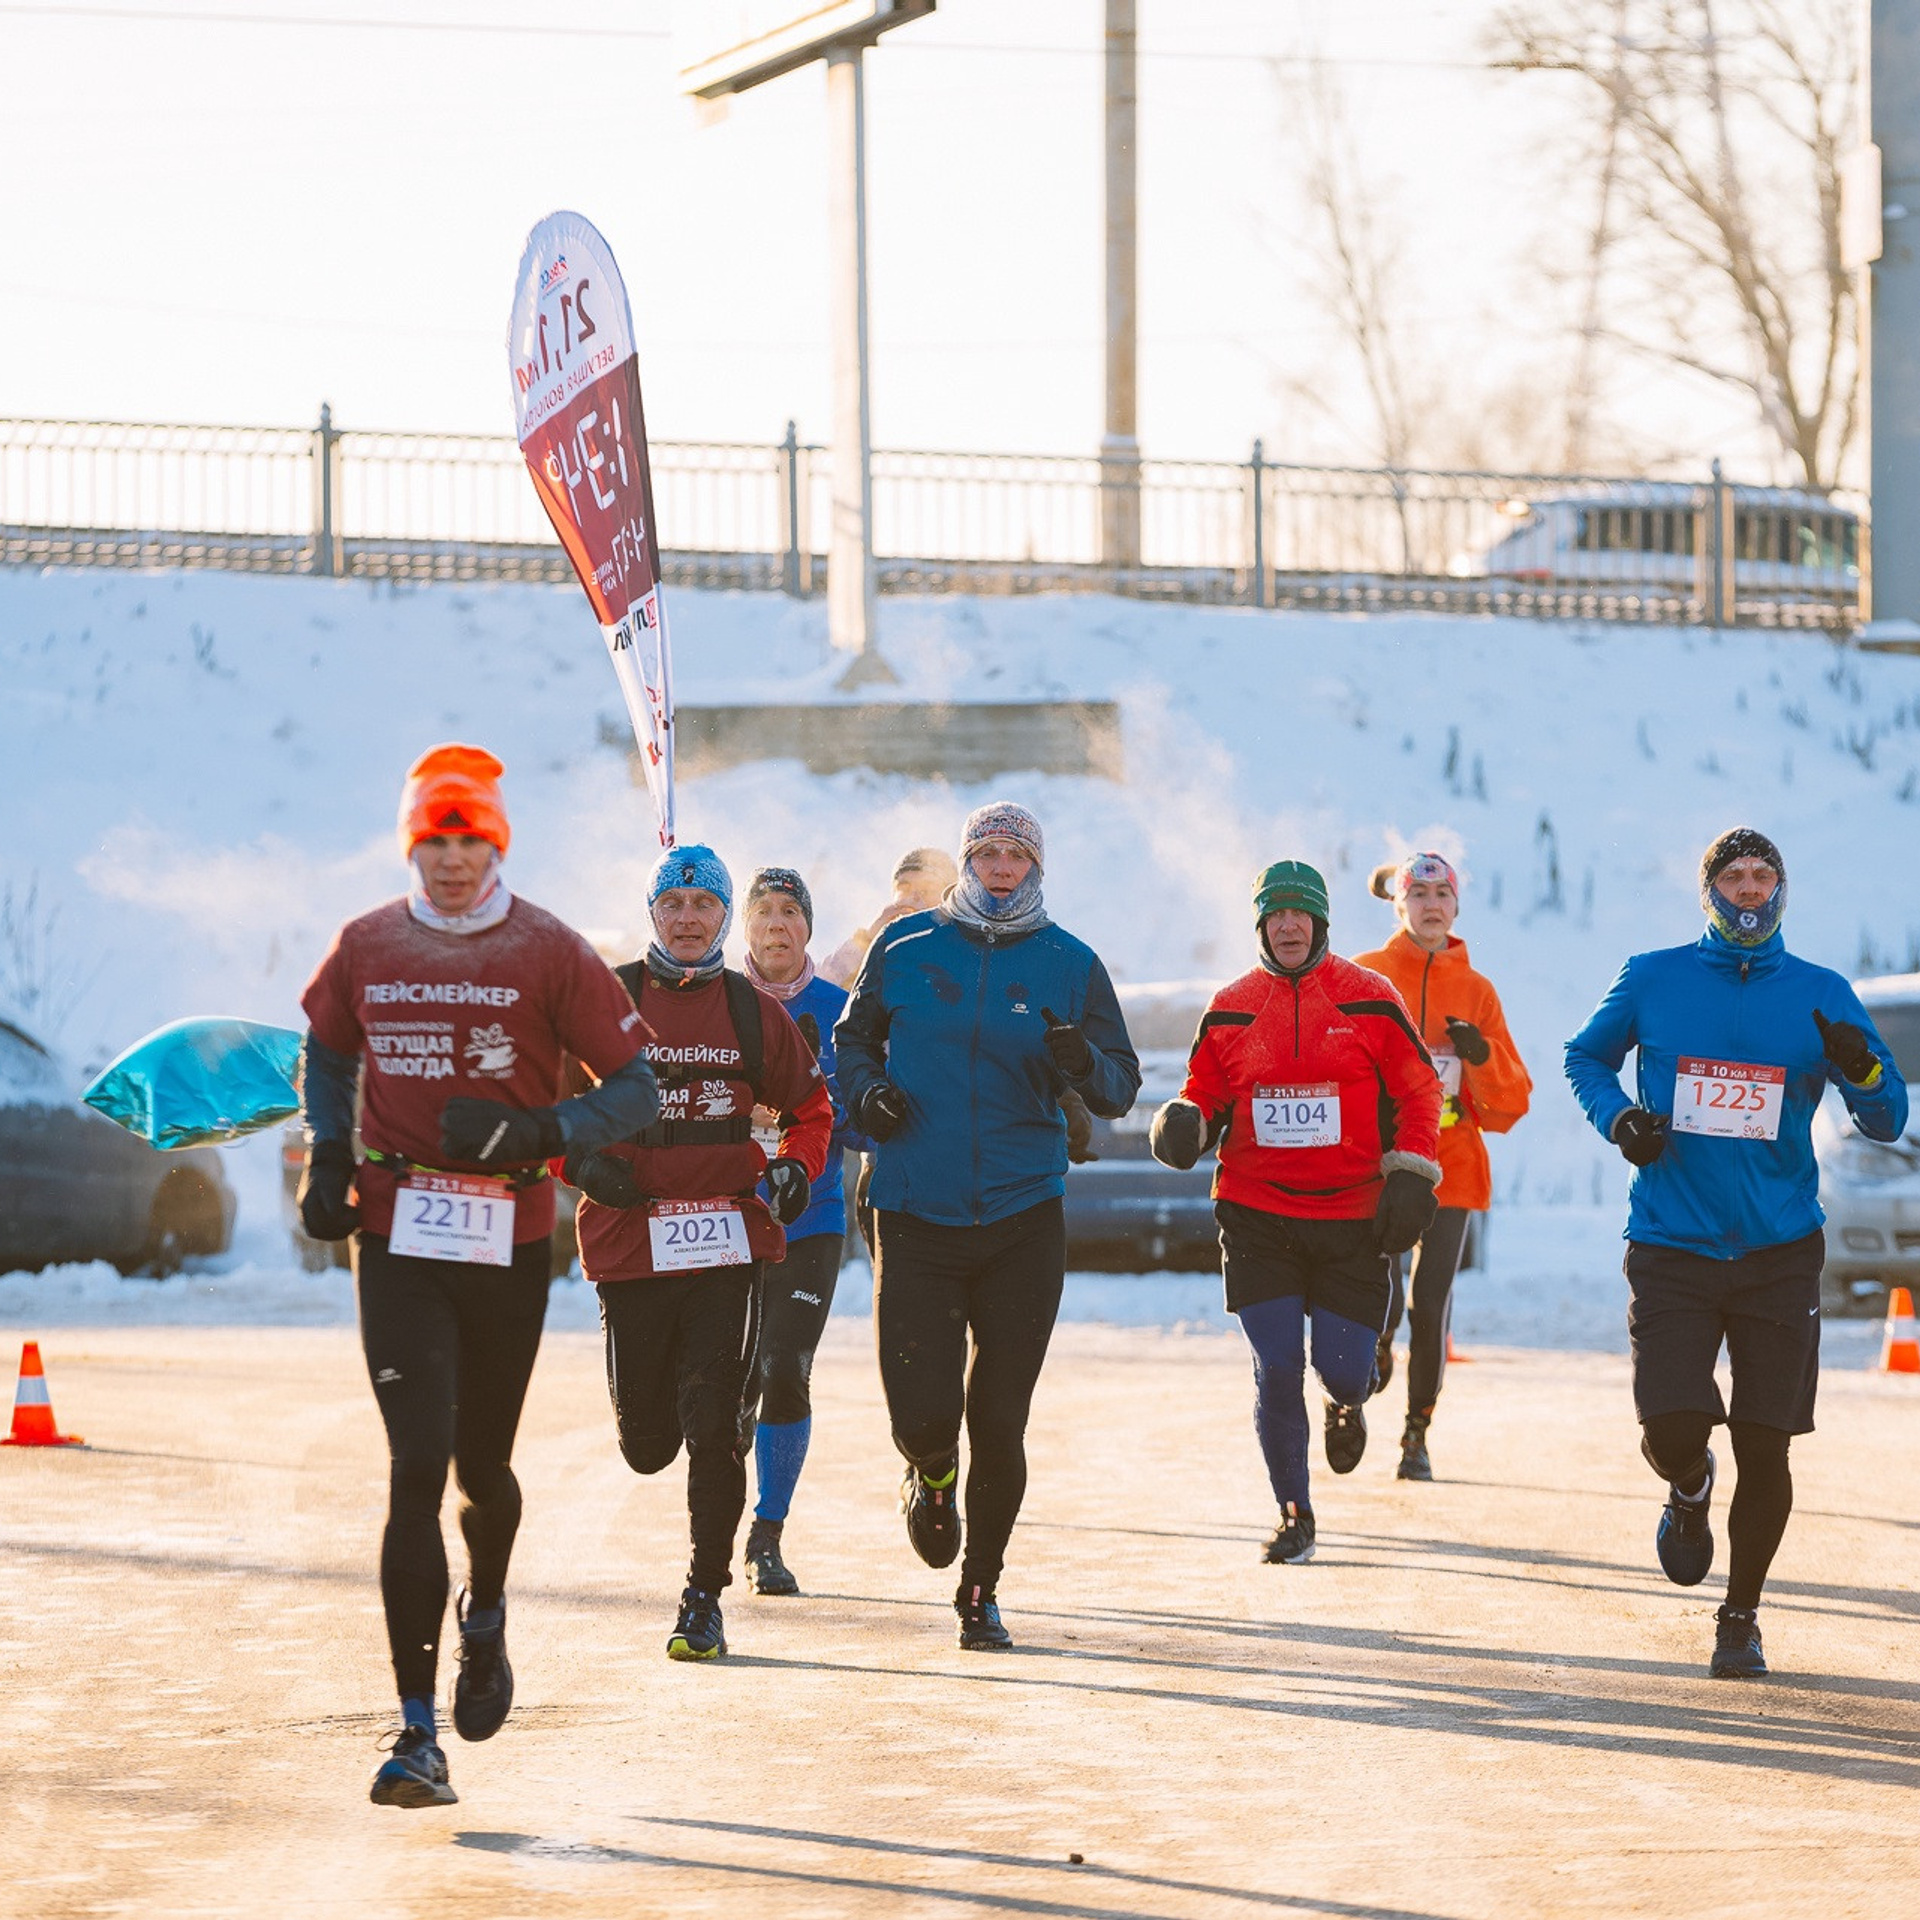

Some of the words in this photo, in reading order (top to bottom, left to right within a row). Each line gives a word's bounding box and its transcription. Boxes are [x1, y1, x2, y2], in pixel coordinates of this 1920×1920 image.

[364, 981, 520, 1007] ПЕЙСМЕЙКЕР
[642, 1043, 740, 1065] ЙСМЕЙКЕР
[1712, 1065, 1727, 1077] 10
[1274, 1088, 1295, 1098] 21,1
[1693, 1081, 1767, 1111] 1225
[1264, 1102, 1328, 1125] 2104
[412, 1195, 494, 1232] 2211
[676, 1201, 699, 1213] 21,1
[665, 1216, 731, 1246] 2021
